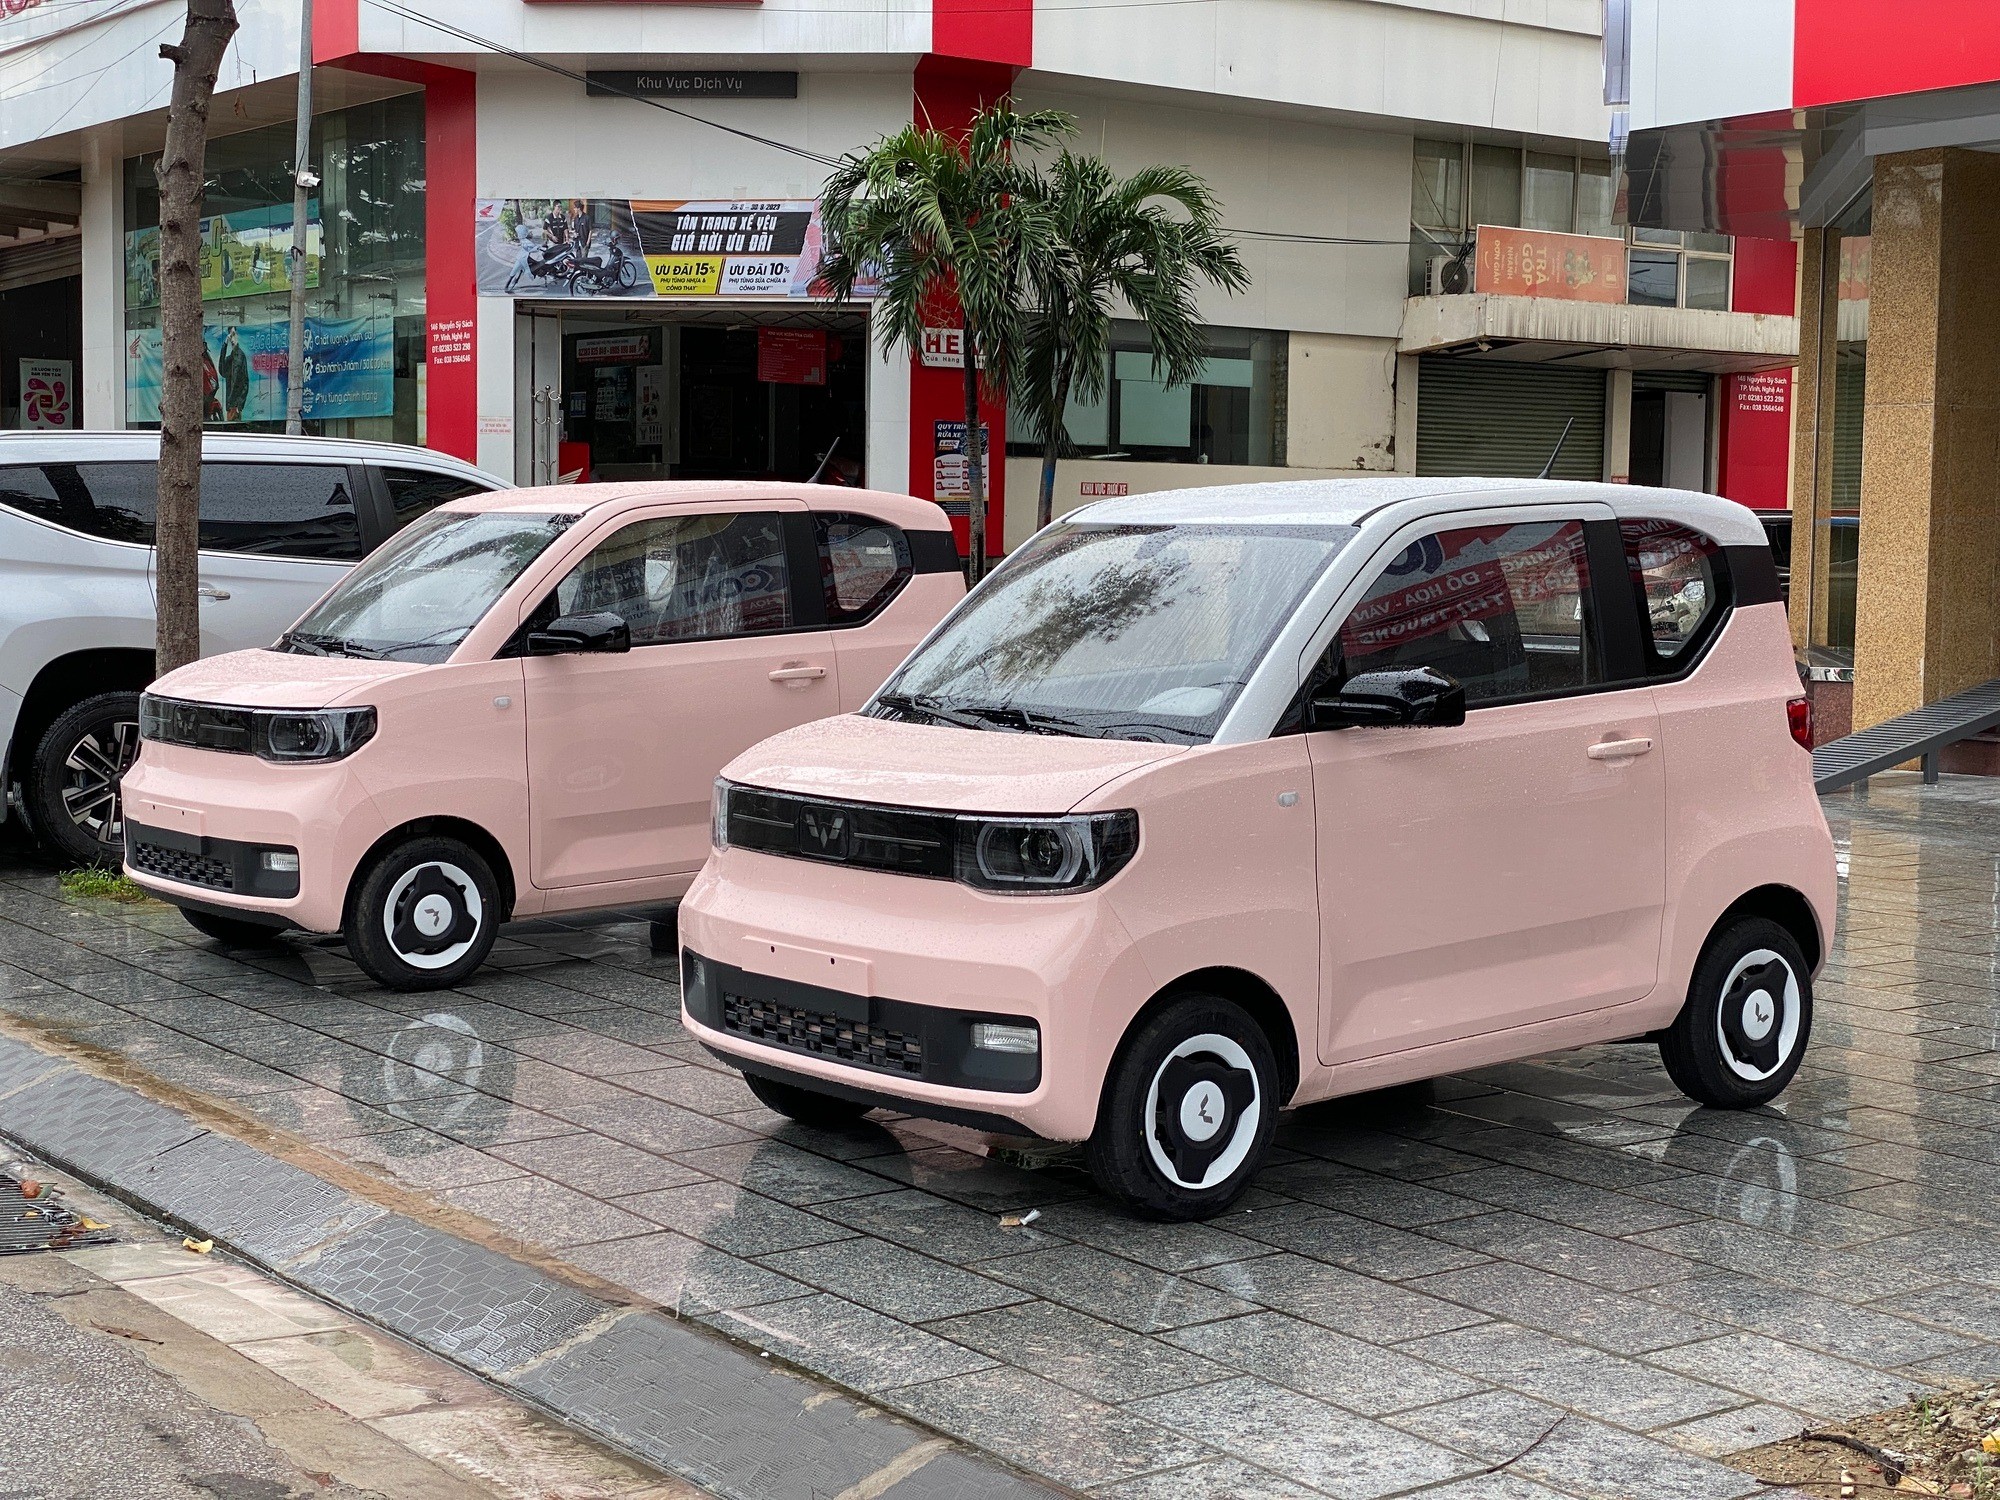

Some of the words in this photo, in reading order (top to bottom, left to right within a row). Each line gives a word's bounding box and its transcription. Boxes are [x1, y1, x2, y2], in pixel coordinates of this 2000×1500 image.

[637, 77, 662, 89] Khu
[666, 77, 690, 91] Vực
[694, 77, 722, 91] Dịch
[726, 77, 742, 92] Vụ
[676, 214, 698, 231] TÂN
[701, 216, 737, 231] TRANG
[739, 213, 757, 231] XẾ
[756, 214, 778, 231] YÊU
[670, 231, 696, 252] GIÁ
[698, 231, 723, 252] HỜI
[725, 232, 746, 252] ƯU
[748, 231, 774, 252] ĐÃI
[656, 265, 670, 275] ƯU
[673, 263, 693, 275] ĐÃI
[695, 262, 715, 275] 15%
[729, 265, 744, 275] ƯU
[747, 263, 768, 275] ĐÃI
[770, 262, 790, 275] 10%
[1522, 243, 1535, 286] GÓP
